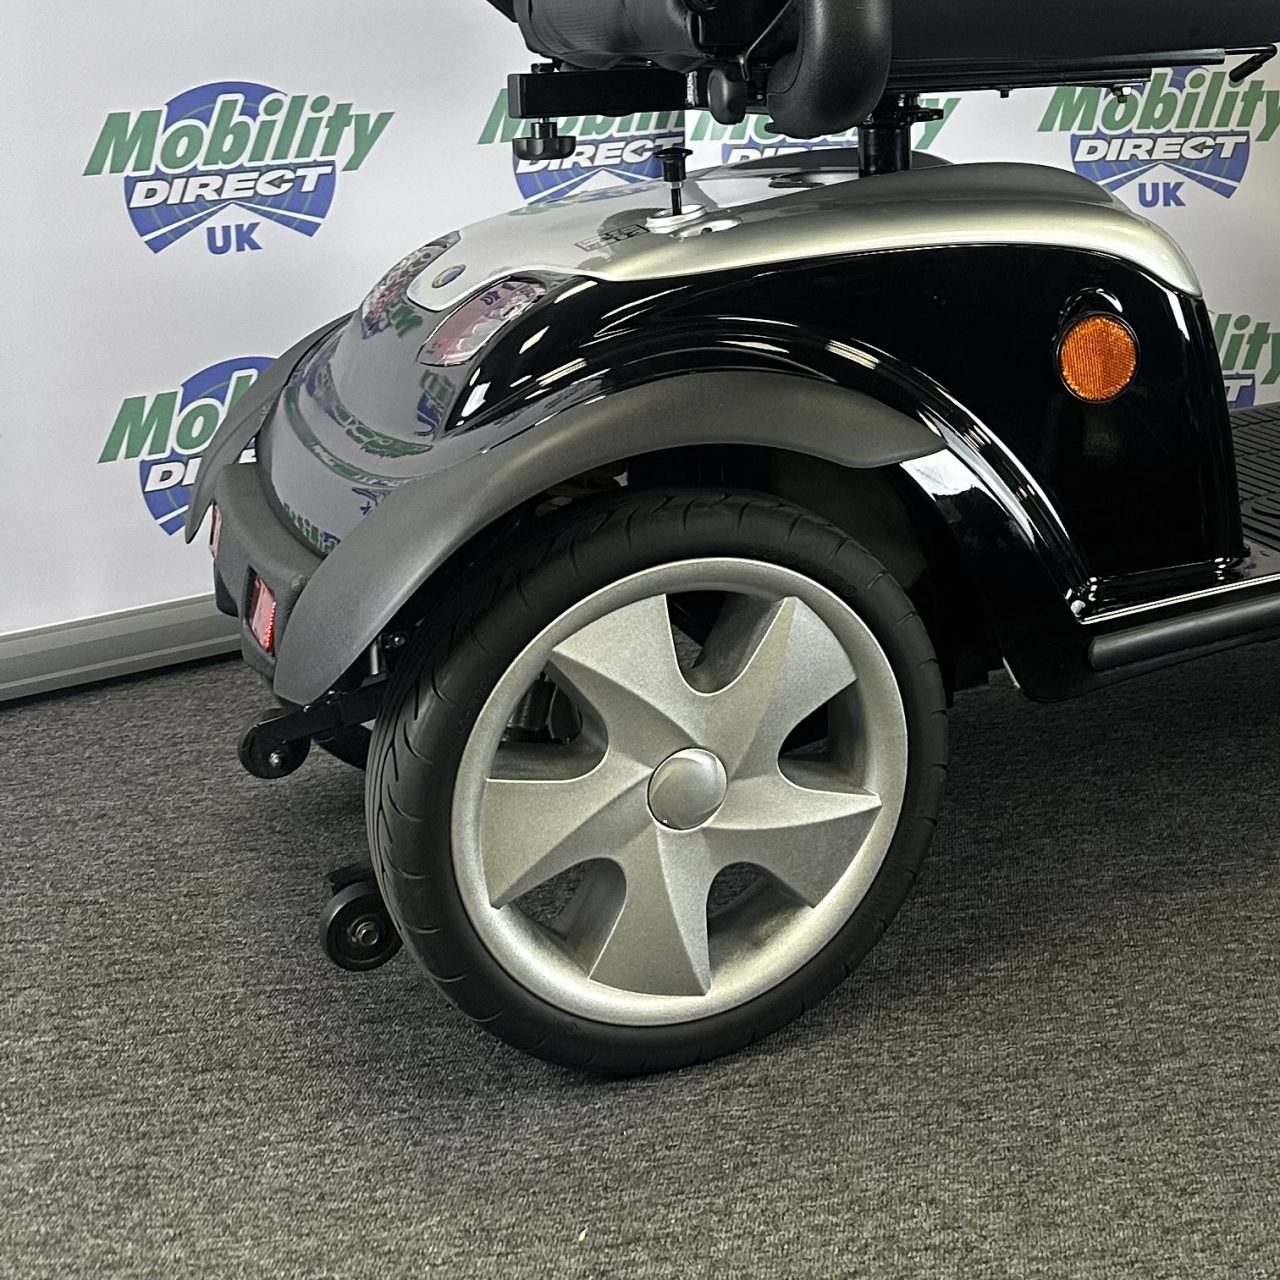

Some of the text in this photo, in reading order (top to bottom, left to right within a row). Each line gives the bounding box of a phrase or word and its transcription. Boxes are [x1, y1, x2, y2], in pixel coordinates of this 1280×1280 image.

[82, 95, 395, 176] Mobility
[1074, 136, 1247, 161] DIRECT
[129, 167, 332, 208] DIRECT
[1138, 182, 1186, 207] UK
[207, 223, 263, 254] UK
